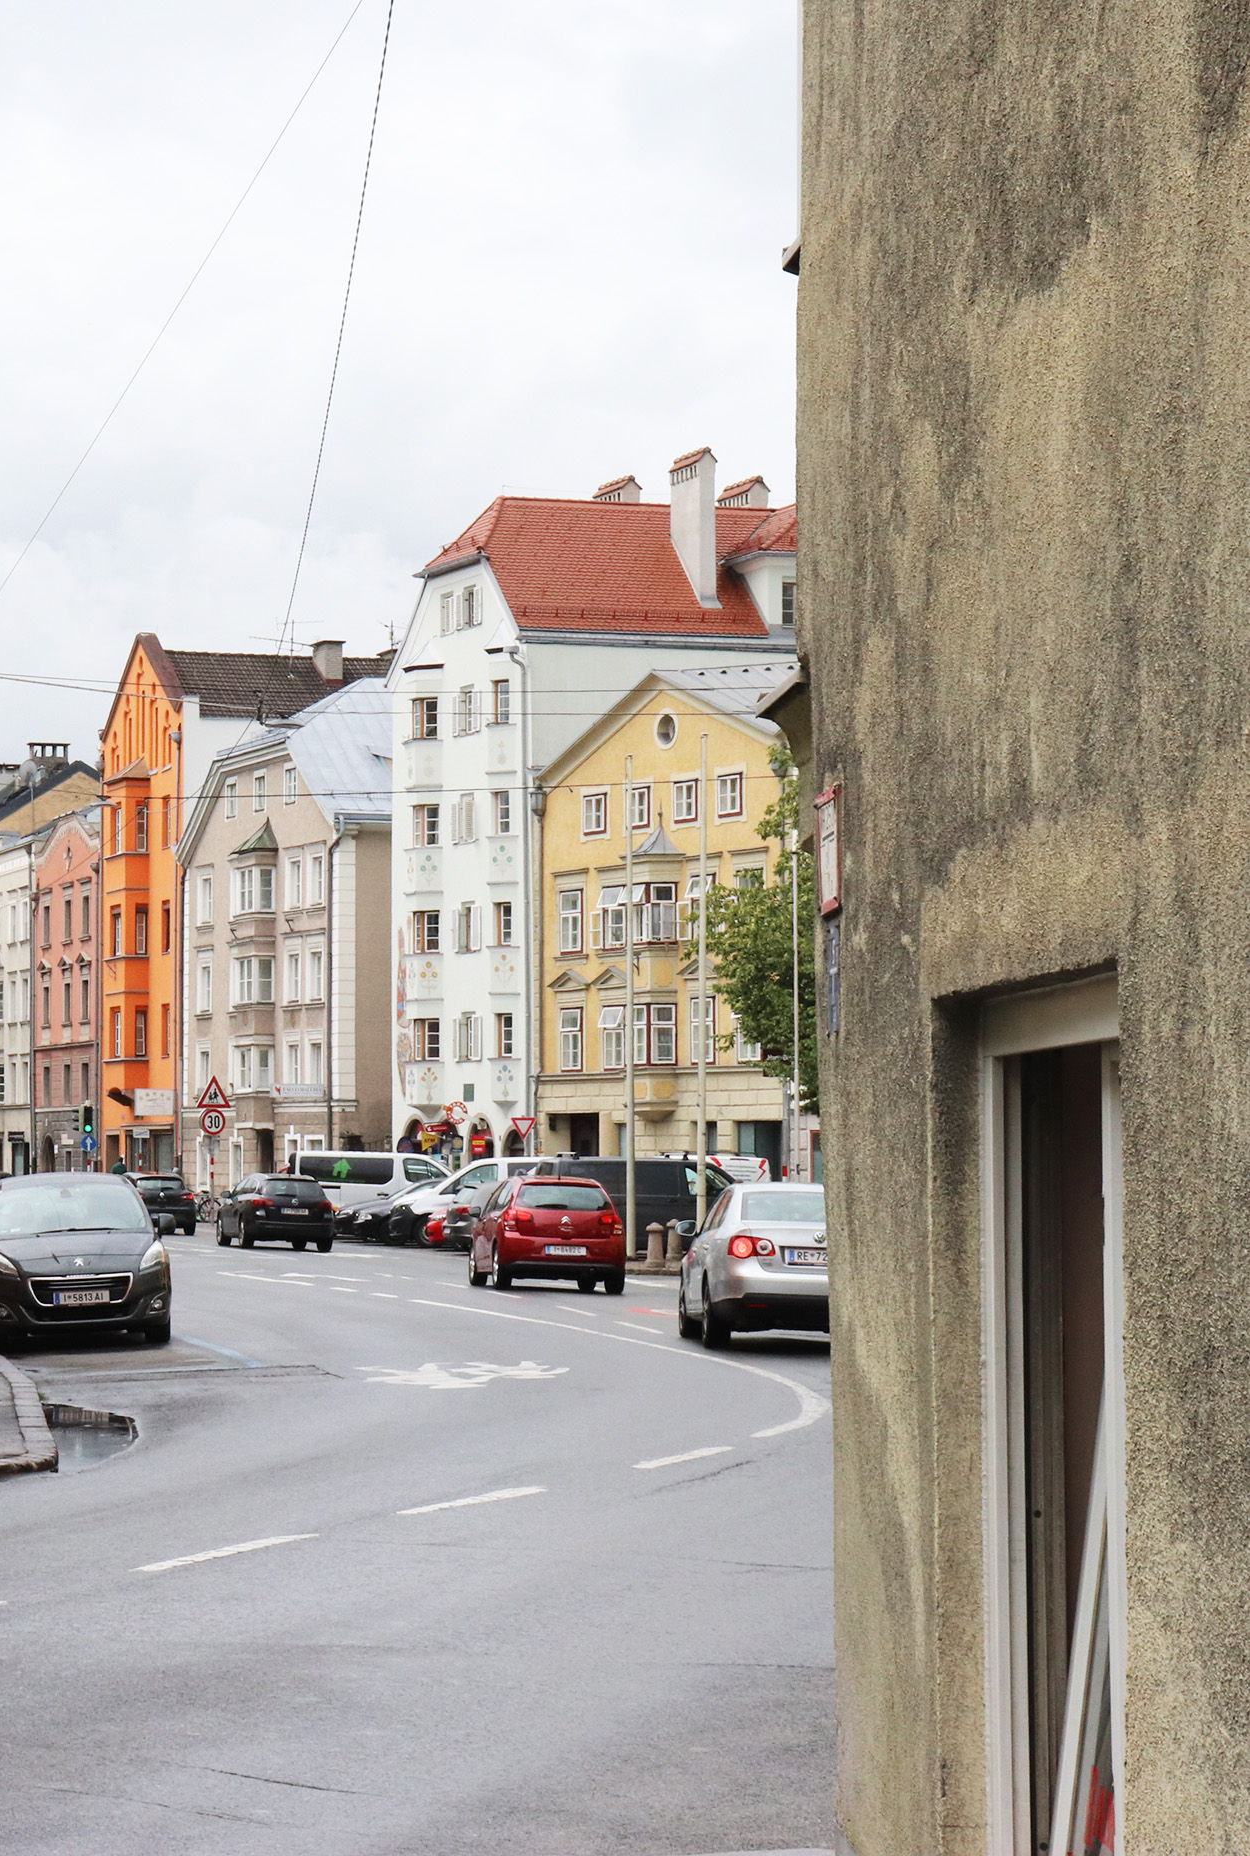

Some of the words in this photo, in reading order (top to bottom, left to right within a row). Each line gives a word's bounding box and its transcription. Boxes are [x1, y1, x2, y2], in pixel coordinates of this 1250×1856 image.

[207, 1115, 220, 1129] 30
[796, 1251, 809, 1261] RE
[72, 1293, 93, 1302] 5813
